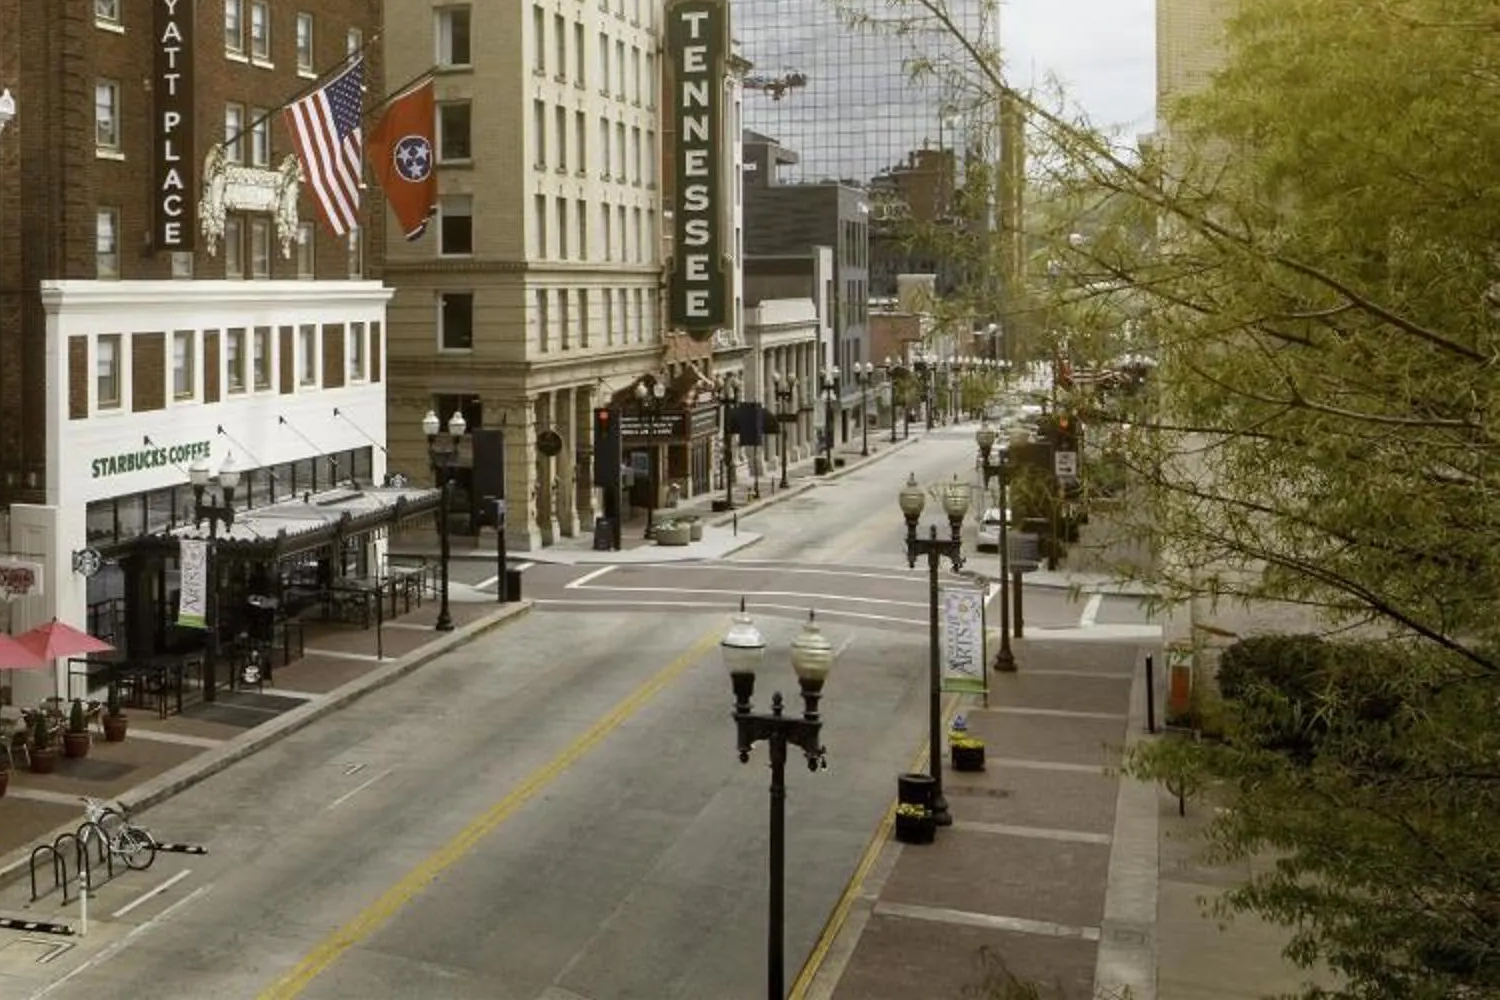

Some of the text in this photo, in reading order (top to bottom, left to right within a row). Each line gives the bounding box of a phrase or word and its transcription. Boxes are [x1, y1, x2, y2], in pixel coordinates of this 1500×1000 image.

[162, 112, 184, 244] PLACE
[681, 11, 711, 318] TENNESSEE
[91, 440, 211, 479] STARBUCKS COFFEE
